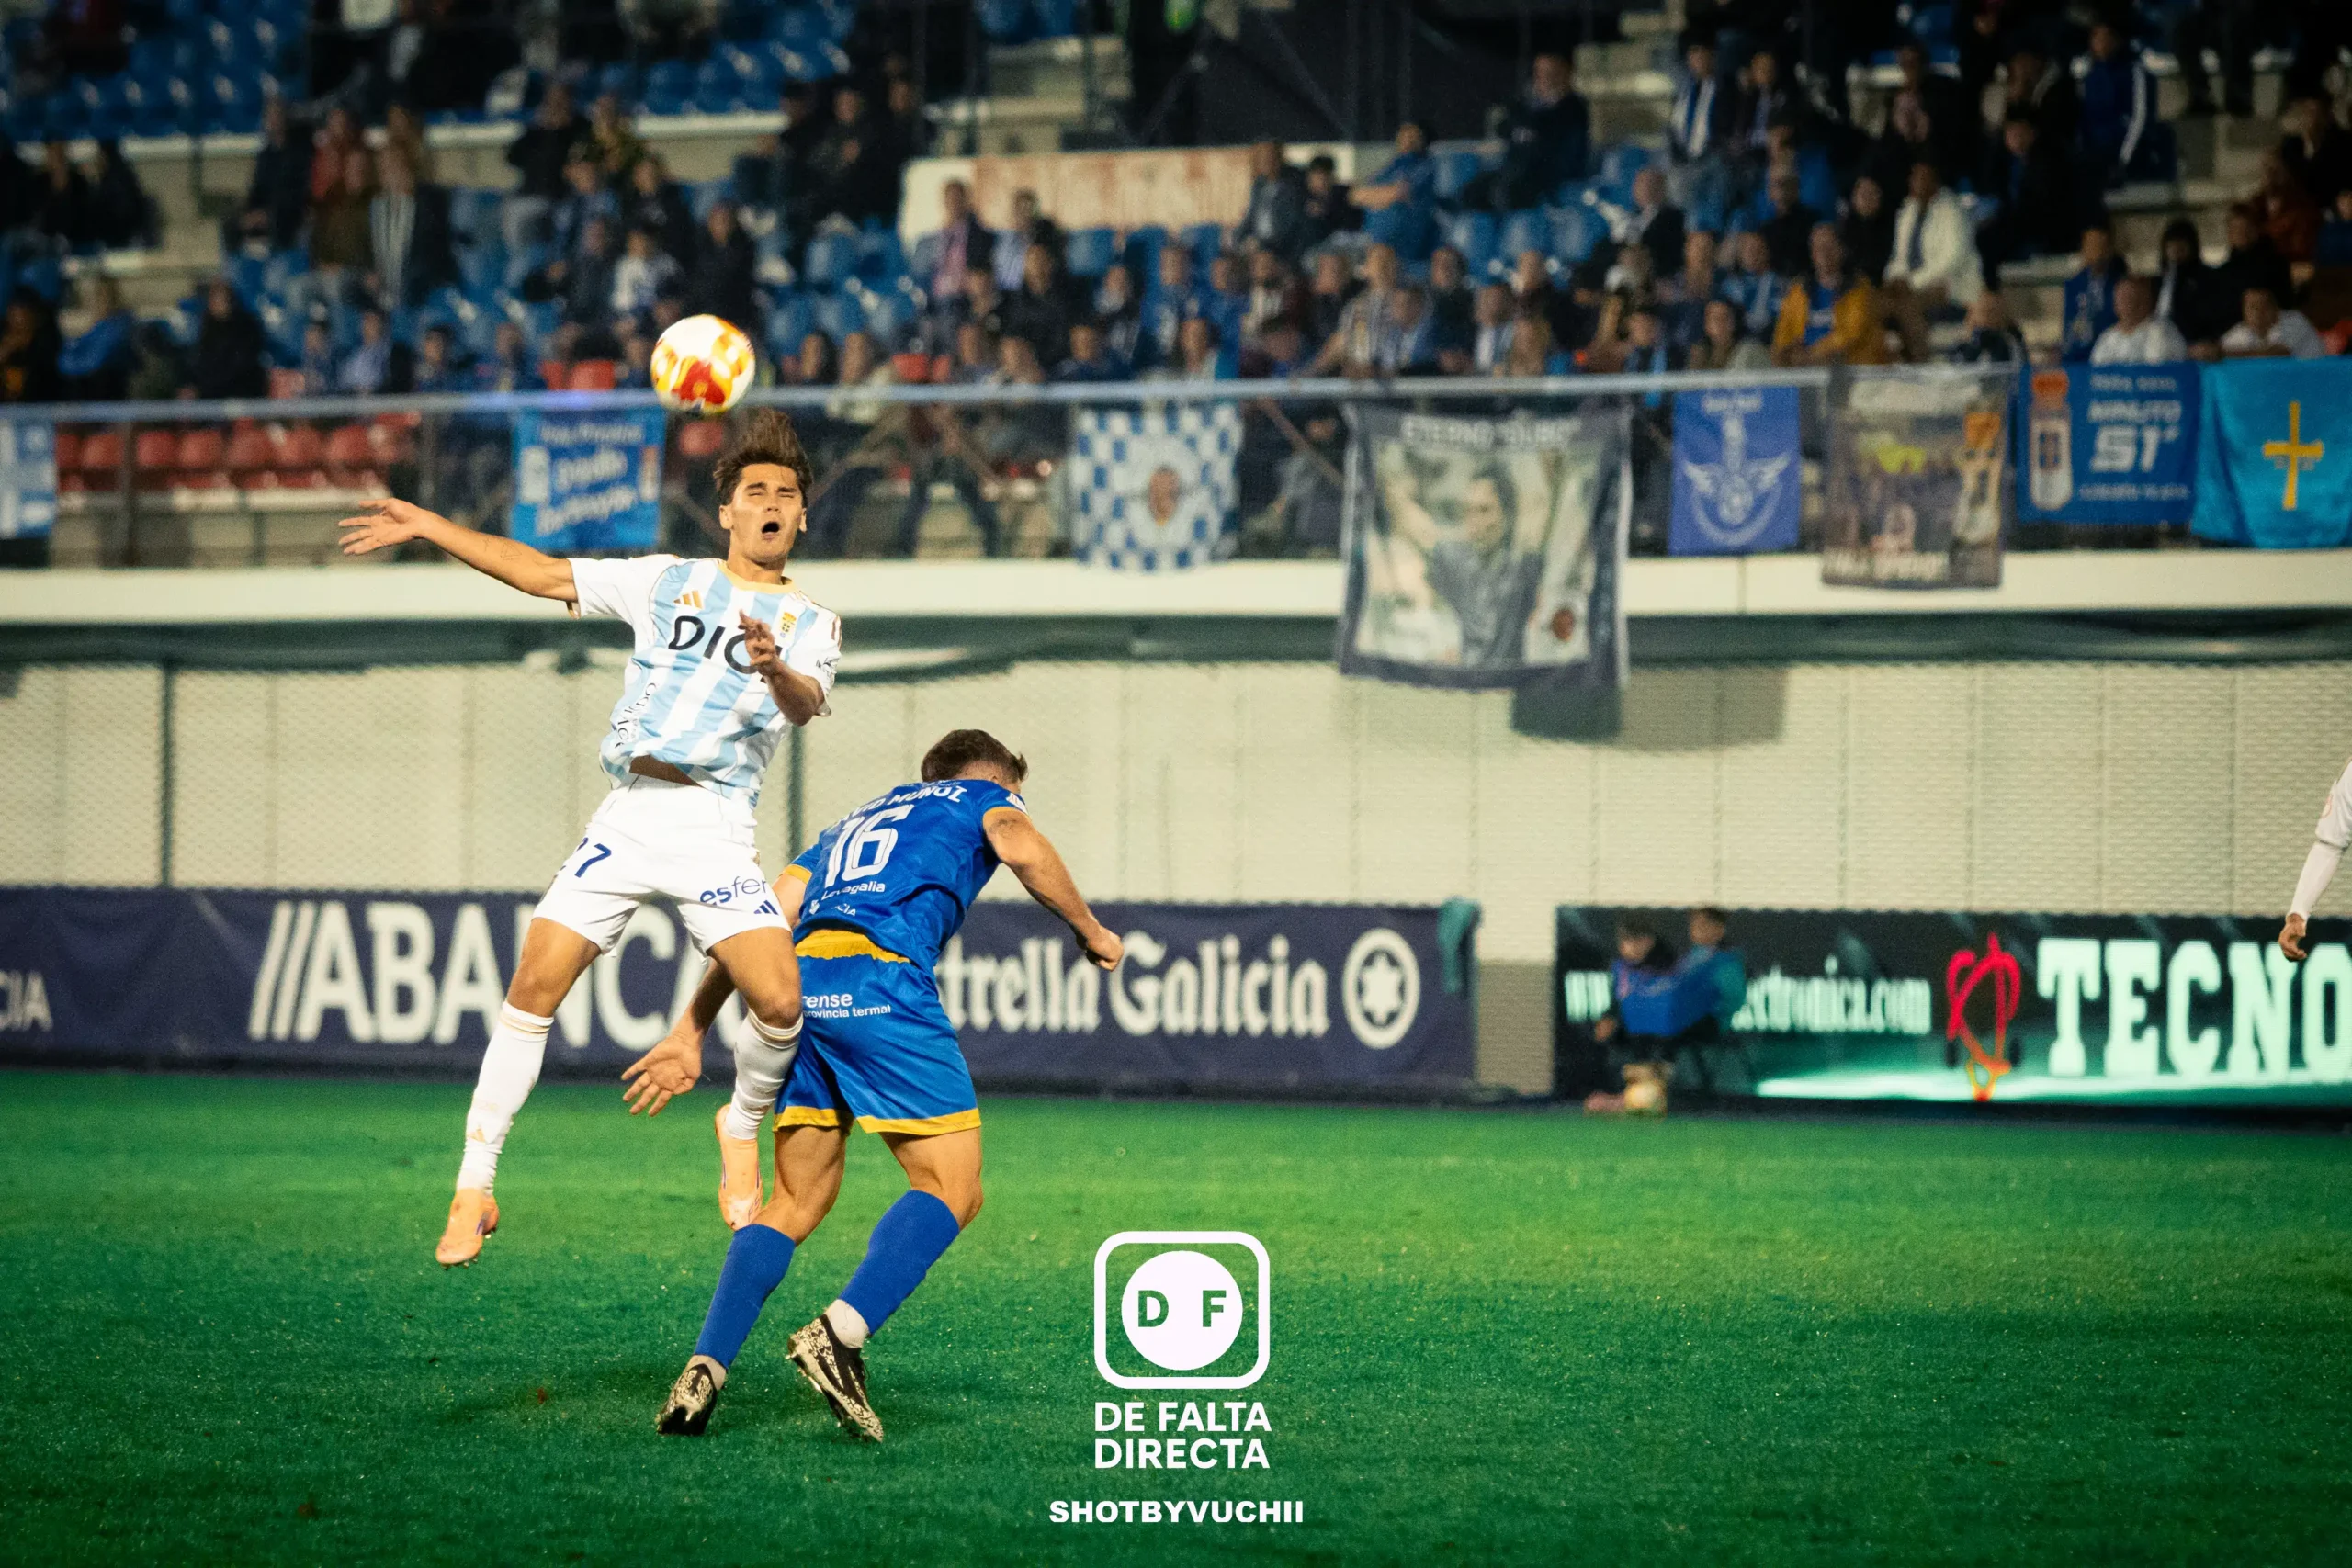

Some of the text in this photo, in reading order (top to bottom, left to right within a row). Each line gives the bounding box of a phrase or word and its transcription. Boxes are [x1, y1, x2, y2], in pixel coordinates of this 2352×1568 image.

[824, 804, 914, 889] 16
[852, 1004, 891, 1017] termal
[1108, 930, 1330, 1038] Galicia
[2037, 938, 2352, 1084] TECNO
